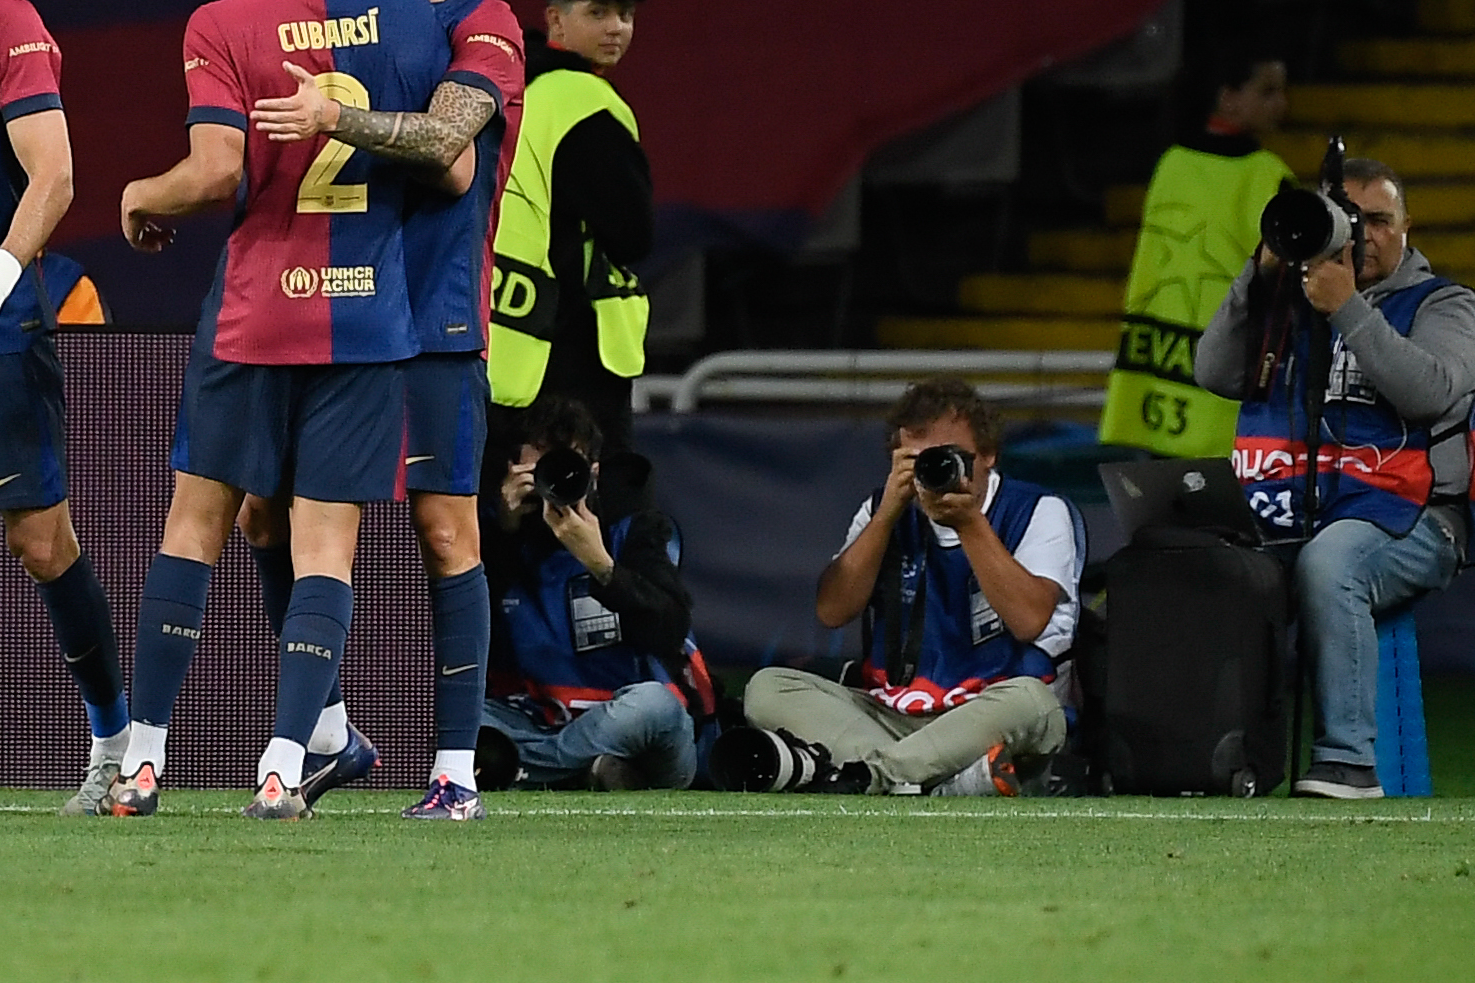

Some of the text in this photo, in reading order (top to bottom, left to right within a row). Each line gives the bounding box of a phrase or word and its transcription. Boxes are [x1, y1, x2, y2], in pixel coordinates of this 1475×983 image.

[277, 7, 379, 53] CUBARSÍ
[296, 72, 371, 214] 2
[320, 266, 374, 280] UNHCR
[321, 279, 375, 292] ACNUR
[1127, 322, 1195, 376] EVA
[1142, 392, 1187, 436] 63
